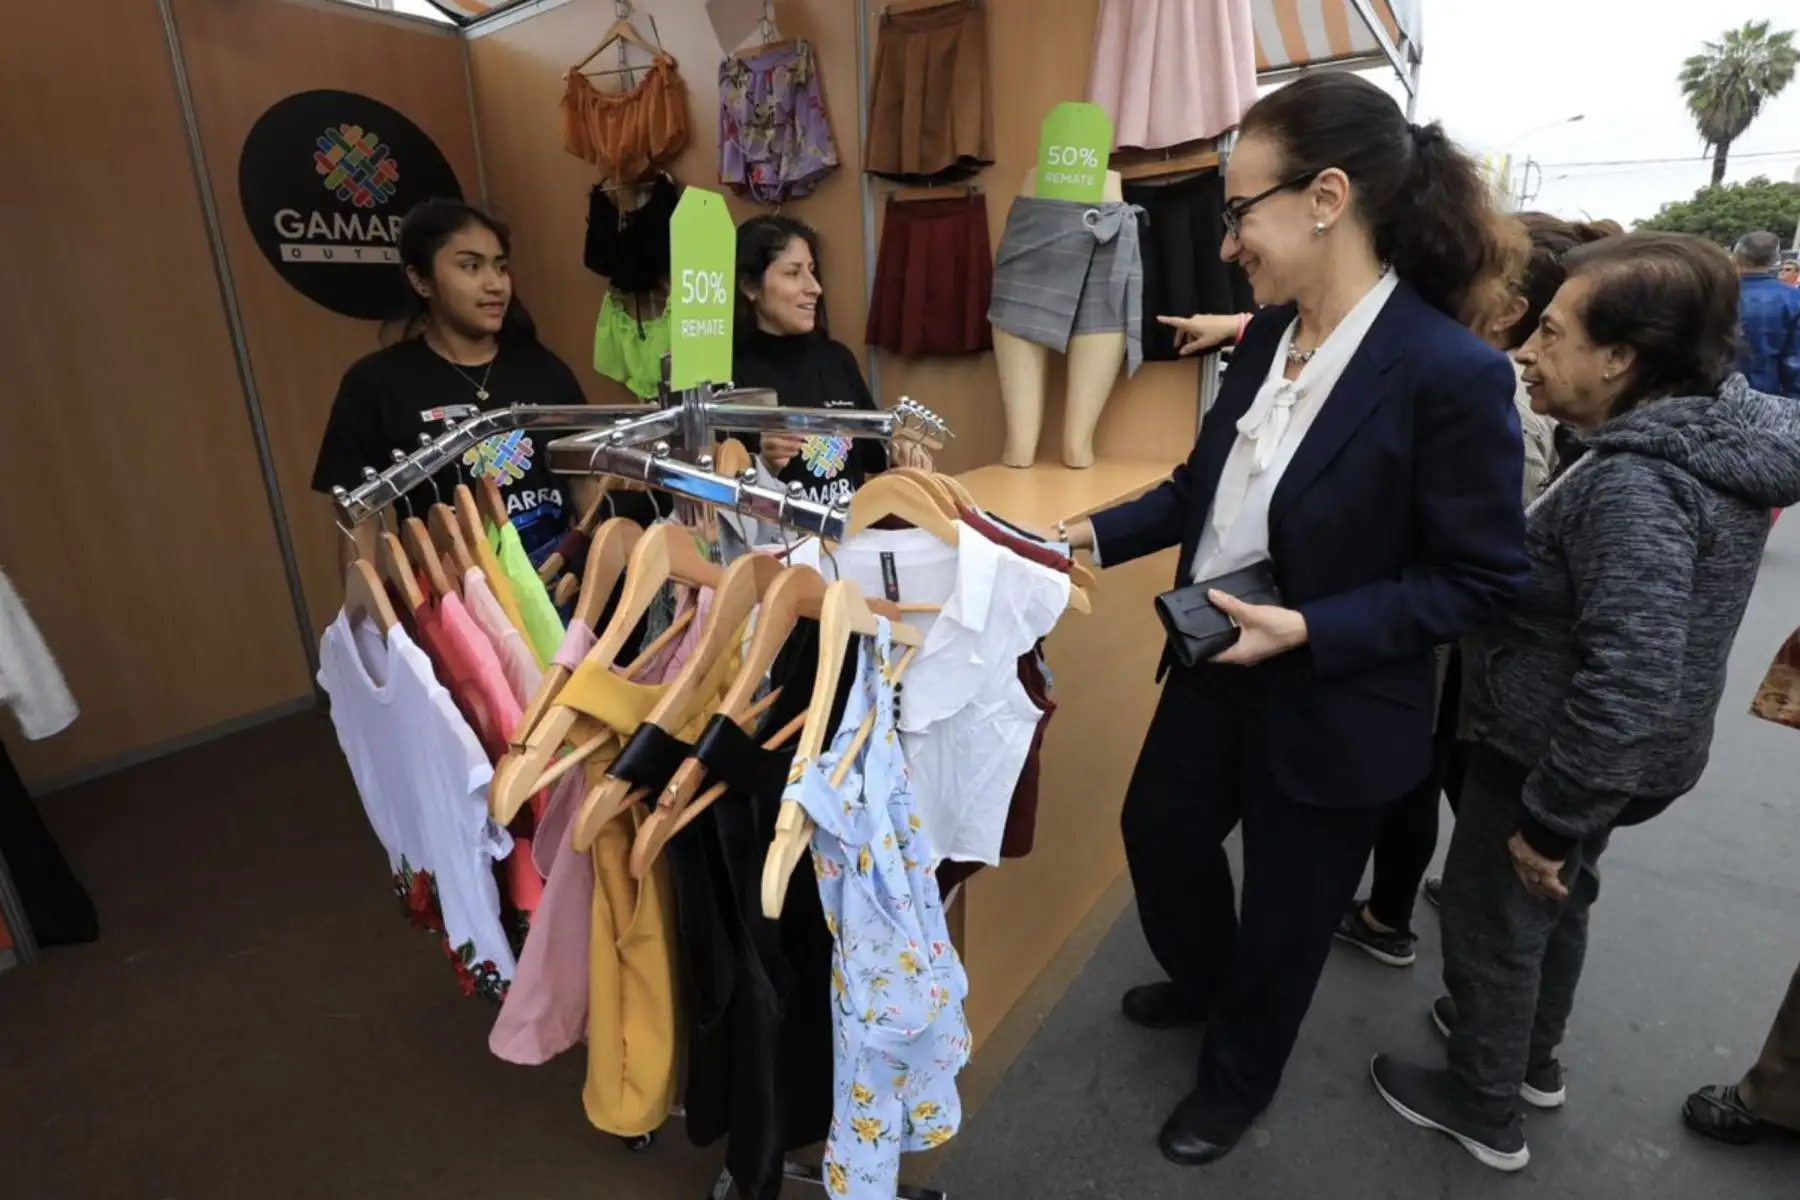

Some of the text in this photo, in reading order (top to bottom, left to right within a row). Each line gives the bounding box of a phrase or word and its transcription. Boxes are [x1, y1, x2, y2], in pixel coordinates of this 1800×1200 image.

[1047, 145, 1098, 168] 50%
[1044, 172, 1095, 186] REMATE
[273, 207, 403, 243] GAMAR
[290, 247, 394, 261] OUTL
[681, 269, 727, 305] 50%
[681, 318, 725, 338] REMATE
[506, 487, 563, 516] ARRA
